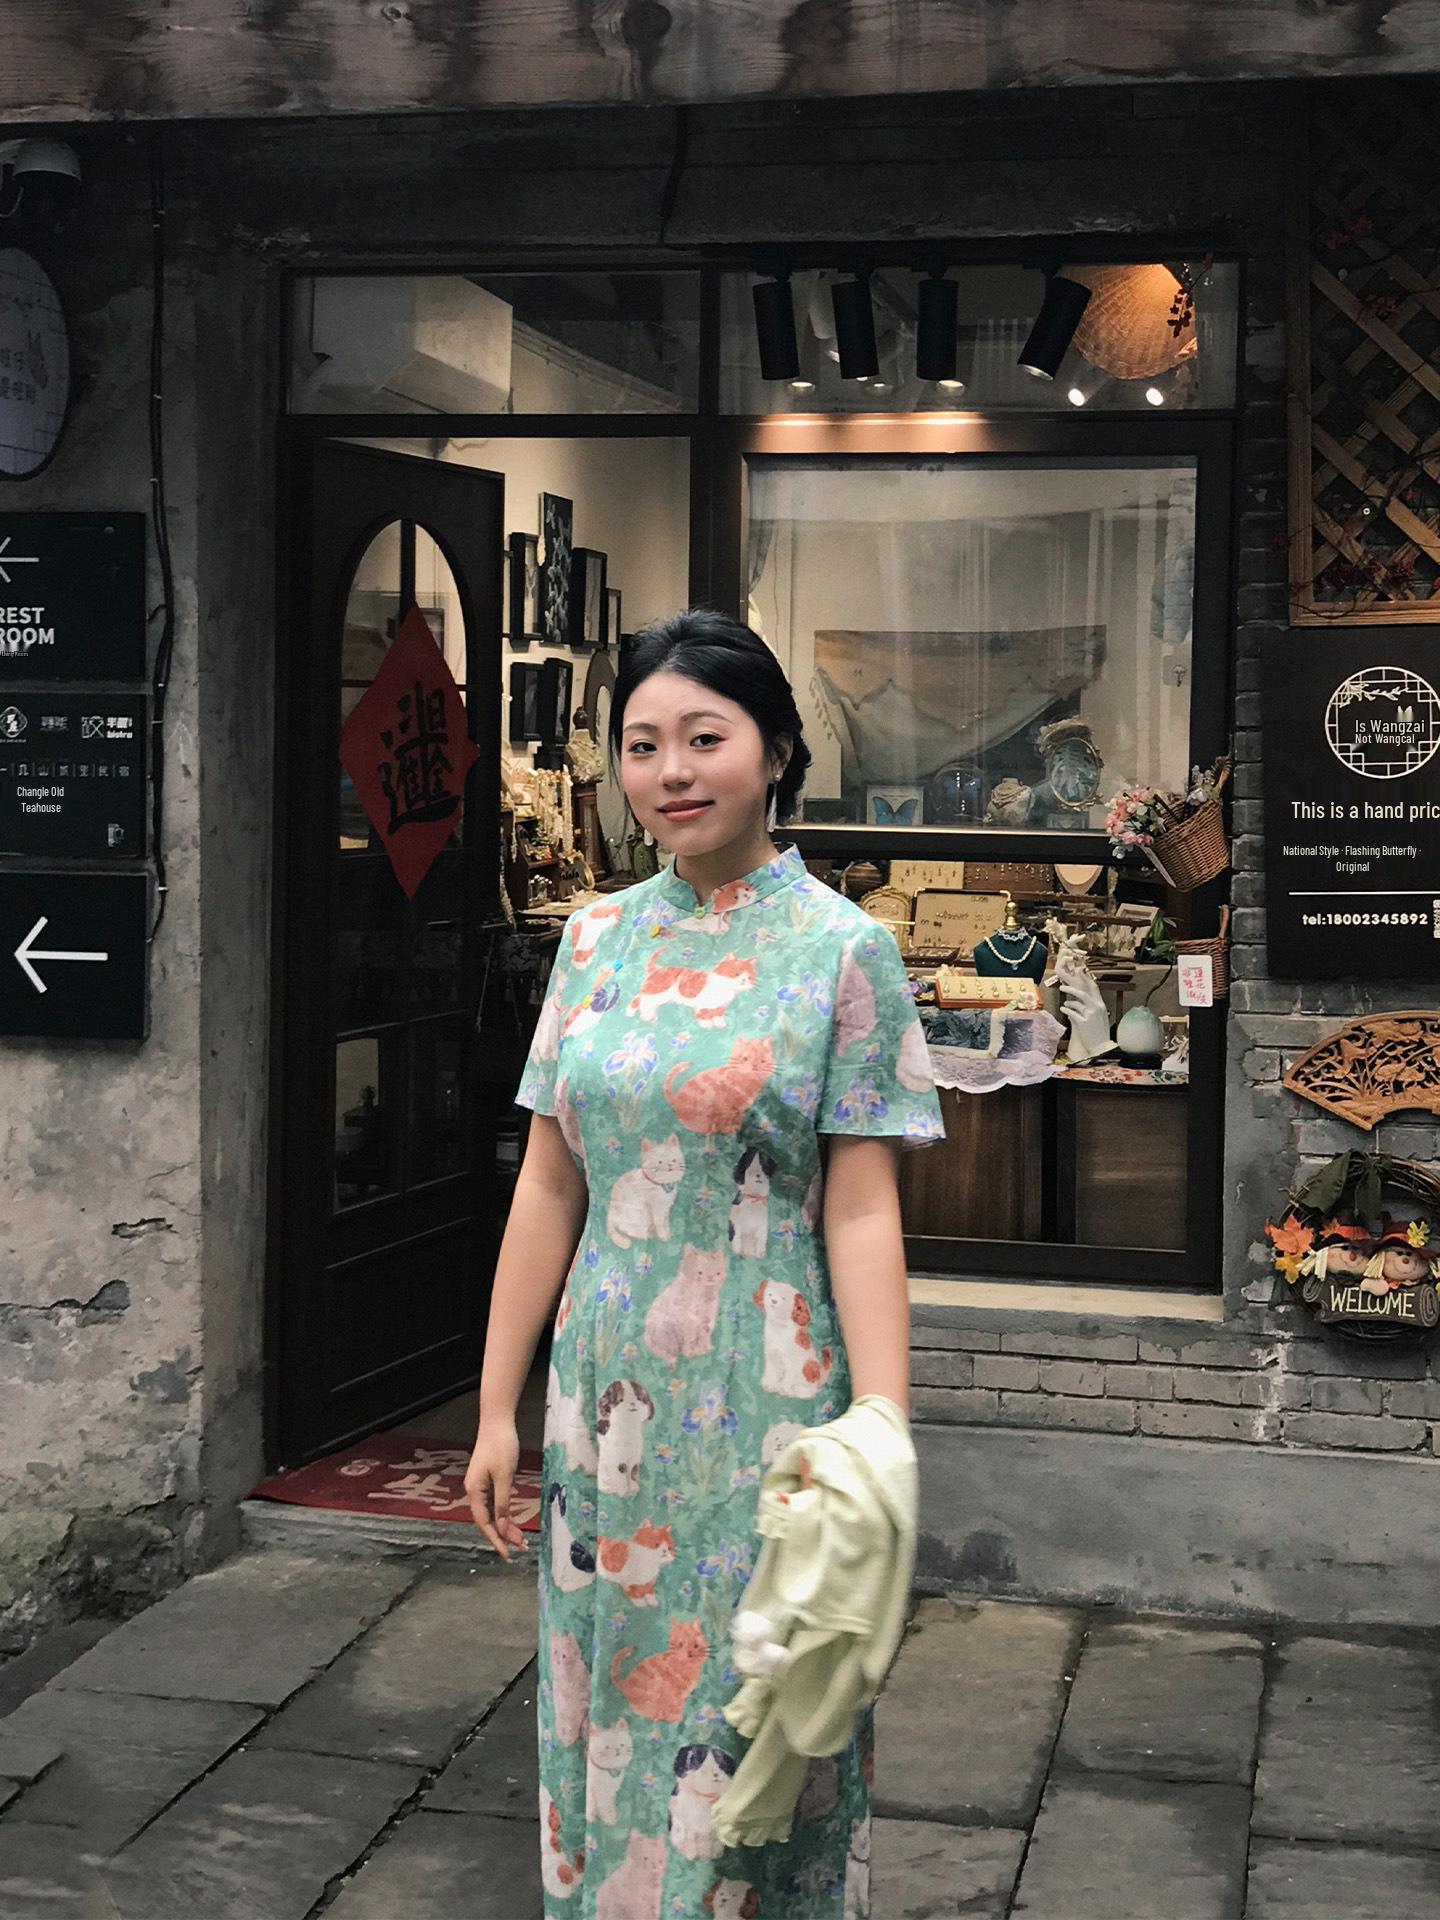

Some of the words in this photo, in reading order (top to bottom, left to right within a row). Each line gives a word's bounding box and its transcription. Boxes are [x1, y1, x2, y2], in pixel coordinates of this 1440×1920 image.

[1355, 719, 1366, 733] Is
[1370, 719, 1425, 736] Wangzai
[1355, 733, 1372, 744] Not
[17, 786, 49, 799] Changle
[51, 786, 65, 797] Old
[21, 802, 61, 813] Teahouse
[1291, 801, 1325, 819] This
[1330, 801, 1343, 819] is
[1349, 805, 1359, 819] a
[1364, 801, 1404, 819] hand
[1283, 845, 1317, 856] National
[1319, 845, 1339, 858] Style
[1345, 845, 1380, 858] Flashing
[1382, 845, 1416, 858] Butterfly
[1336, 861, 1370, 874] Original
[1302, 913, 1428, 926] tel:18002345892
